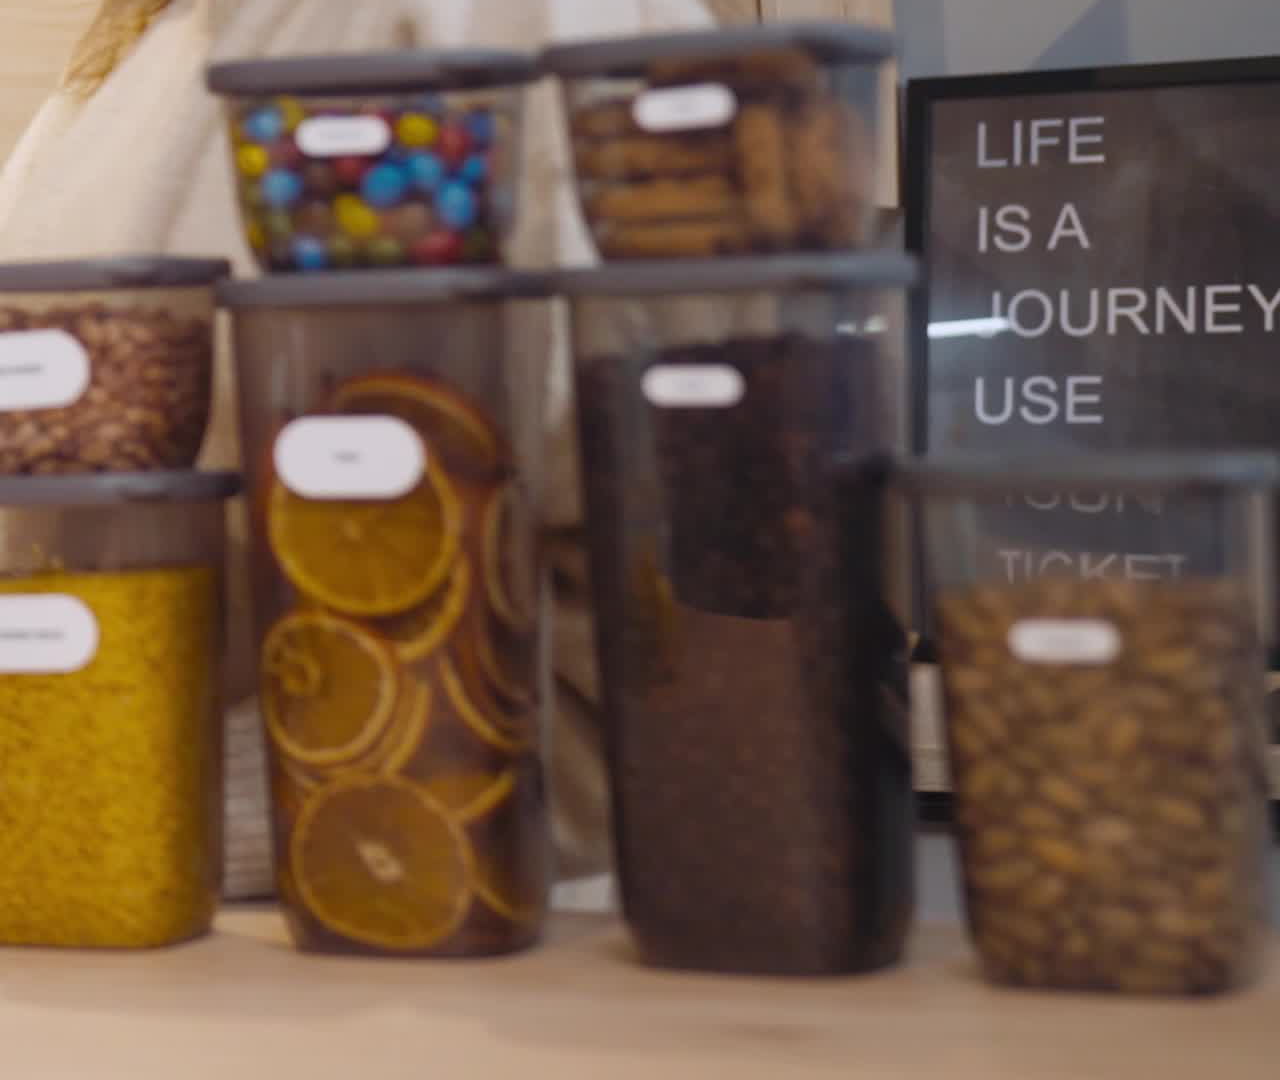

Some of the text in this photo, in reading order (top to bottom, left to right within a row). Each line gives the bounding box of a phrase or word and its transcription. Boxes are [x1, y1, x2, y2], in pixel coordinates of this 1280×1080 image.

[976, 116, 1106, 169] LIFE
[977, 202, 1090, 254] IS A
[973, 375, 1104, 425] USE
